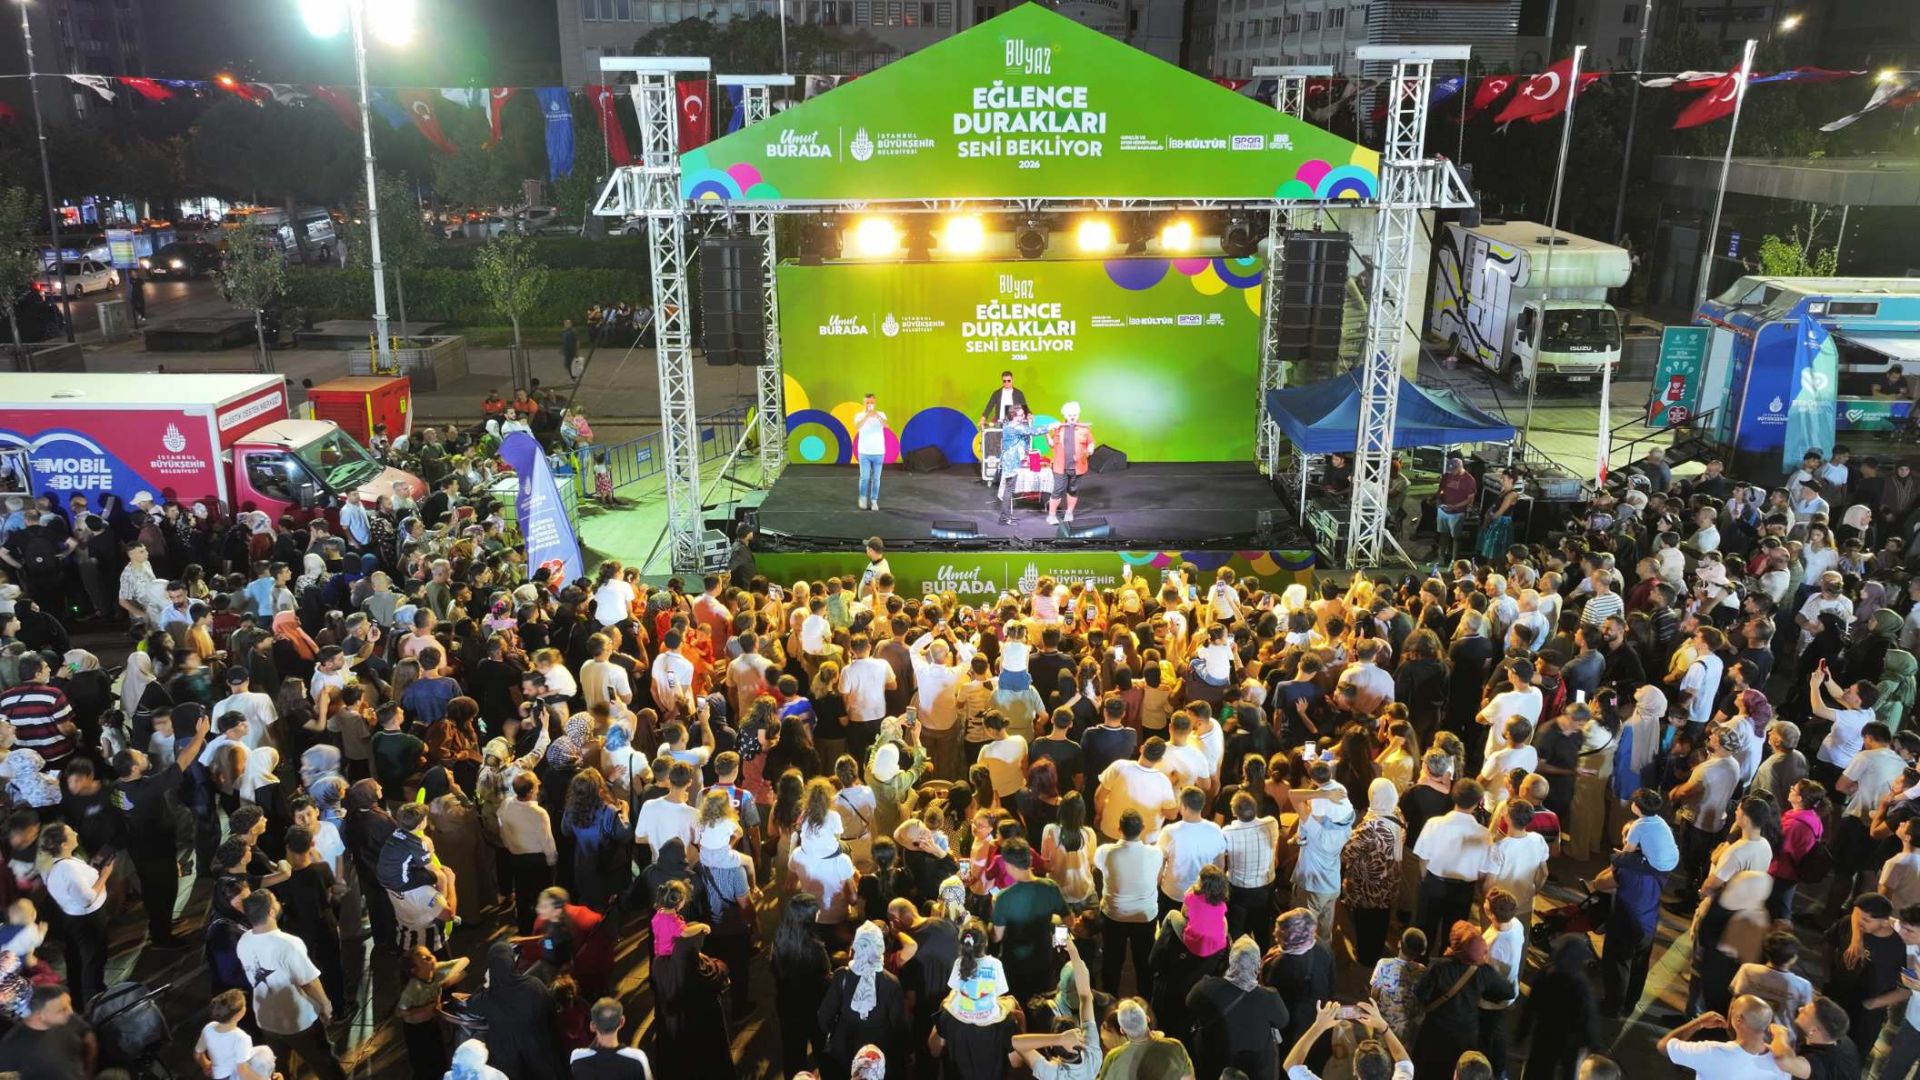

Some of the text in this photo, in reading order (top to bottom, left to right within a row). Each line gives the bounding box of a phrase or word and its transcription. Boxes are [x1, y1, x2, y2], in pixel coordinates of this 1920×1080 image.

[1006, 39, 1024, 66] BU
[973, 80, 1088, 109] EĞLENCE
[953, 111, 1107, 135] DURAKLARI
[780, 129, 819, 145] Umut
[877, 138, 935, 149] BÜYÜKŞEHİR
[1183, 137, 1227, 149] KÜLTÜR
[766, 143, 832, 158] BURADA
[958, 135, 1103, 158] SENİ BEKLİYOR
[1018, 160, 1041, 169] 2026
[999, 274, 1013, 294] BU
[976, 299, 1062, 320] EĞLENCE
[829, 314, 858, 326] Umut
[818, 325, 868, 336] BURADA
[961, 320, 1076, 337] DURAKLARI
[965, 336, 1074, 353] SENİ BEKLİYOR
[150, 459, 206, 469] BÜYÜKŞEHİR
[57, 474, 113, 490] BÜFE
[937, 565, 981, 582] Umut
[922, 579, 996, 594] BURADA
